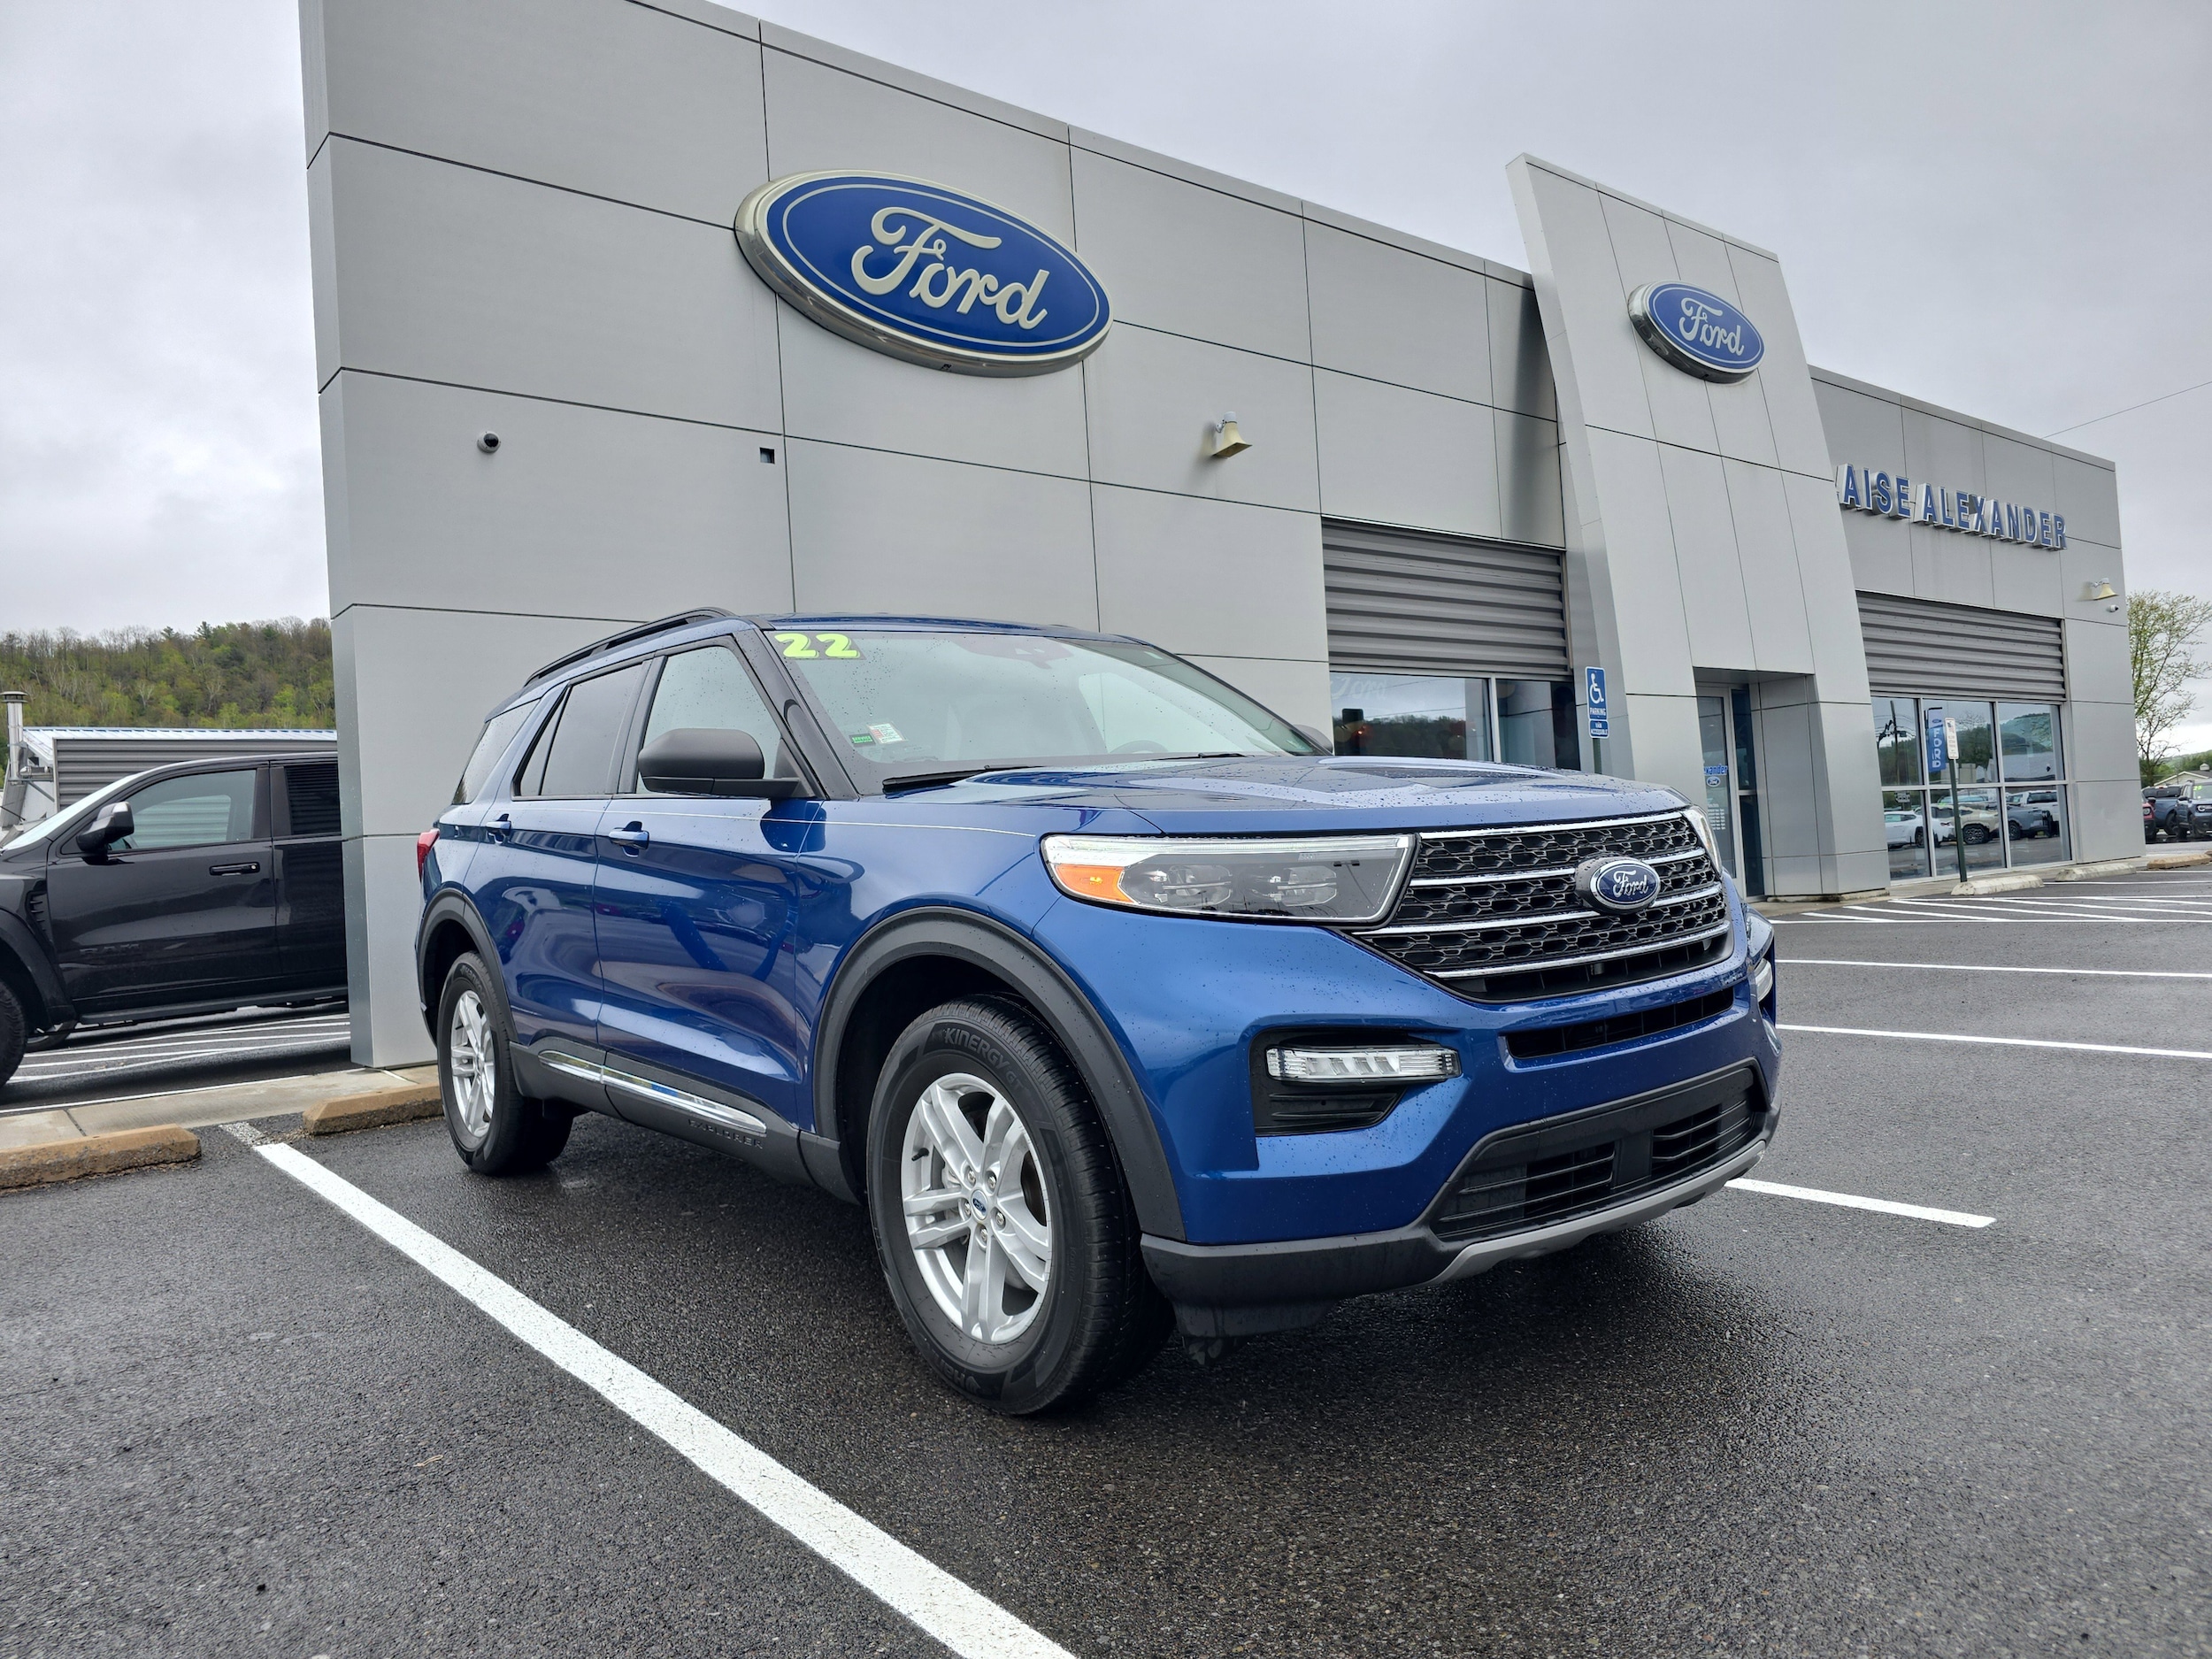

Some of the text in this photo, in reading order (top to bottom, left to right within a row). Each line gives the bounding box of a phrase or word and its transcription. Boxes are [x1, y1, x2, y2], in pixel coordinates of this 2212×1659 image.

[851, 206, 1049, 330] Ford
[1678, 297, 1744, 356] Ford
[1837, 463, 2067, 549] AISE ALEXANDER
[774, 633, 860, 659] 22
[1932, 728, 1943, 768] FORD
[1612, 870, 1649, 898] Ford
[944, 1027, 1010, 1069] KINERGY
[688, 1118, 764, 1149] EXPLORER
